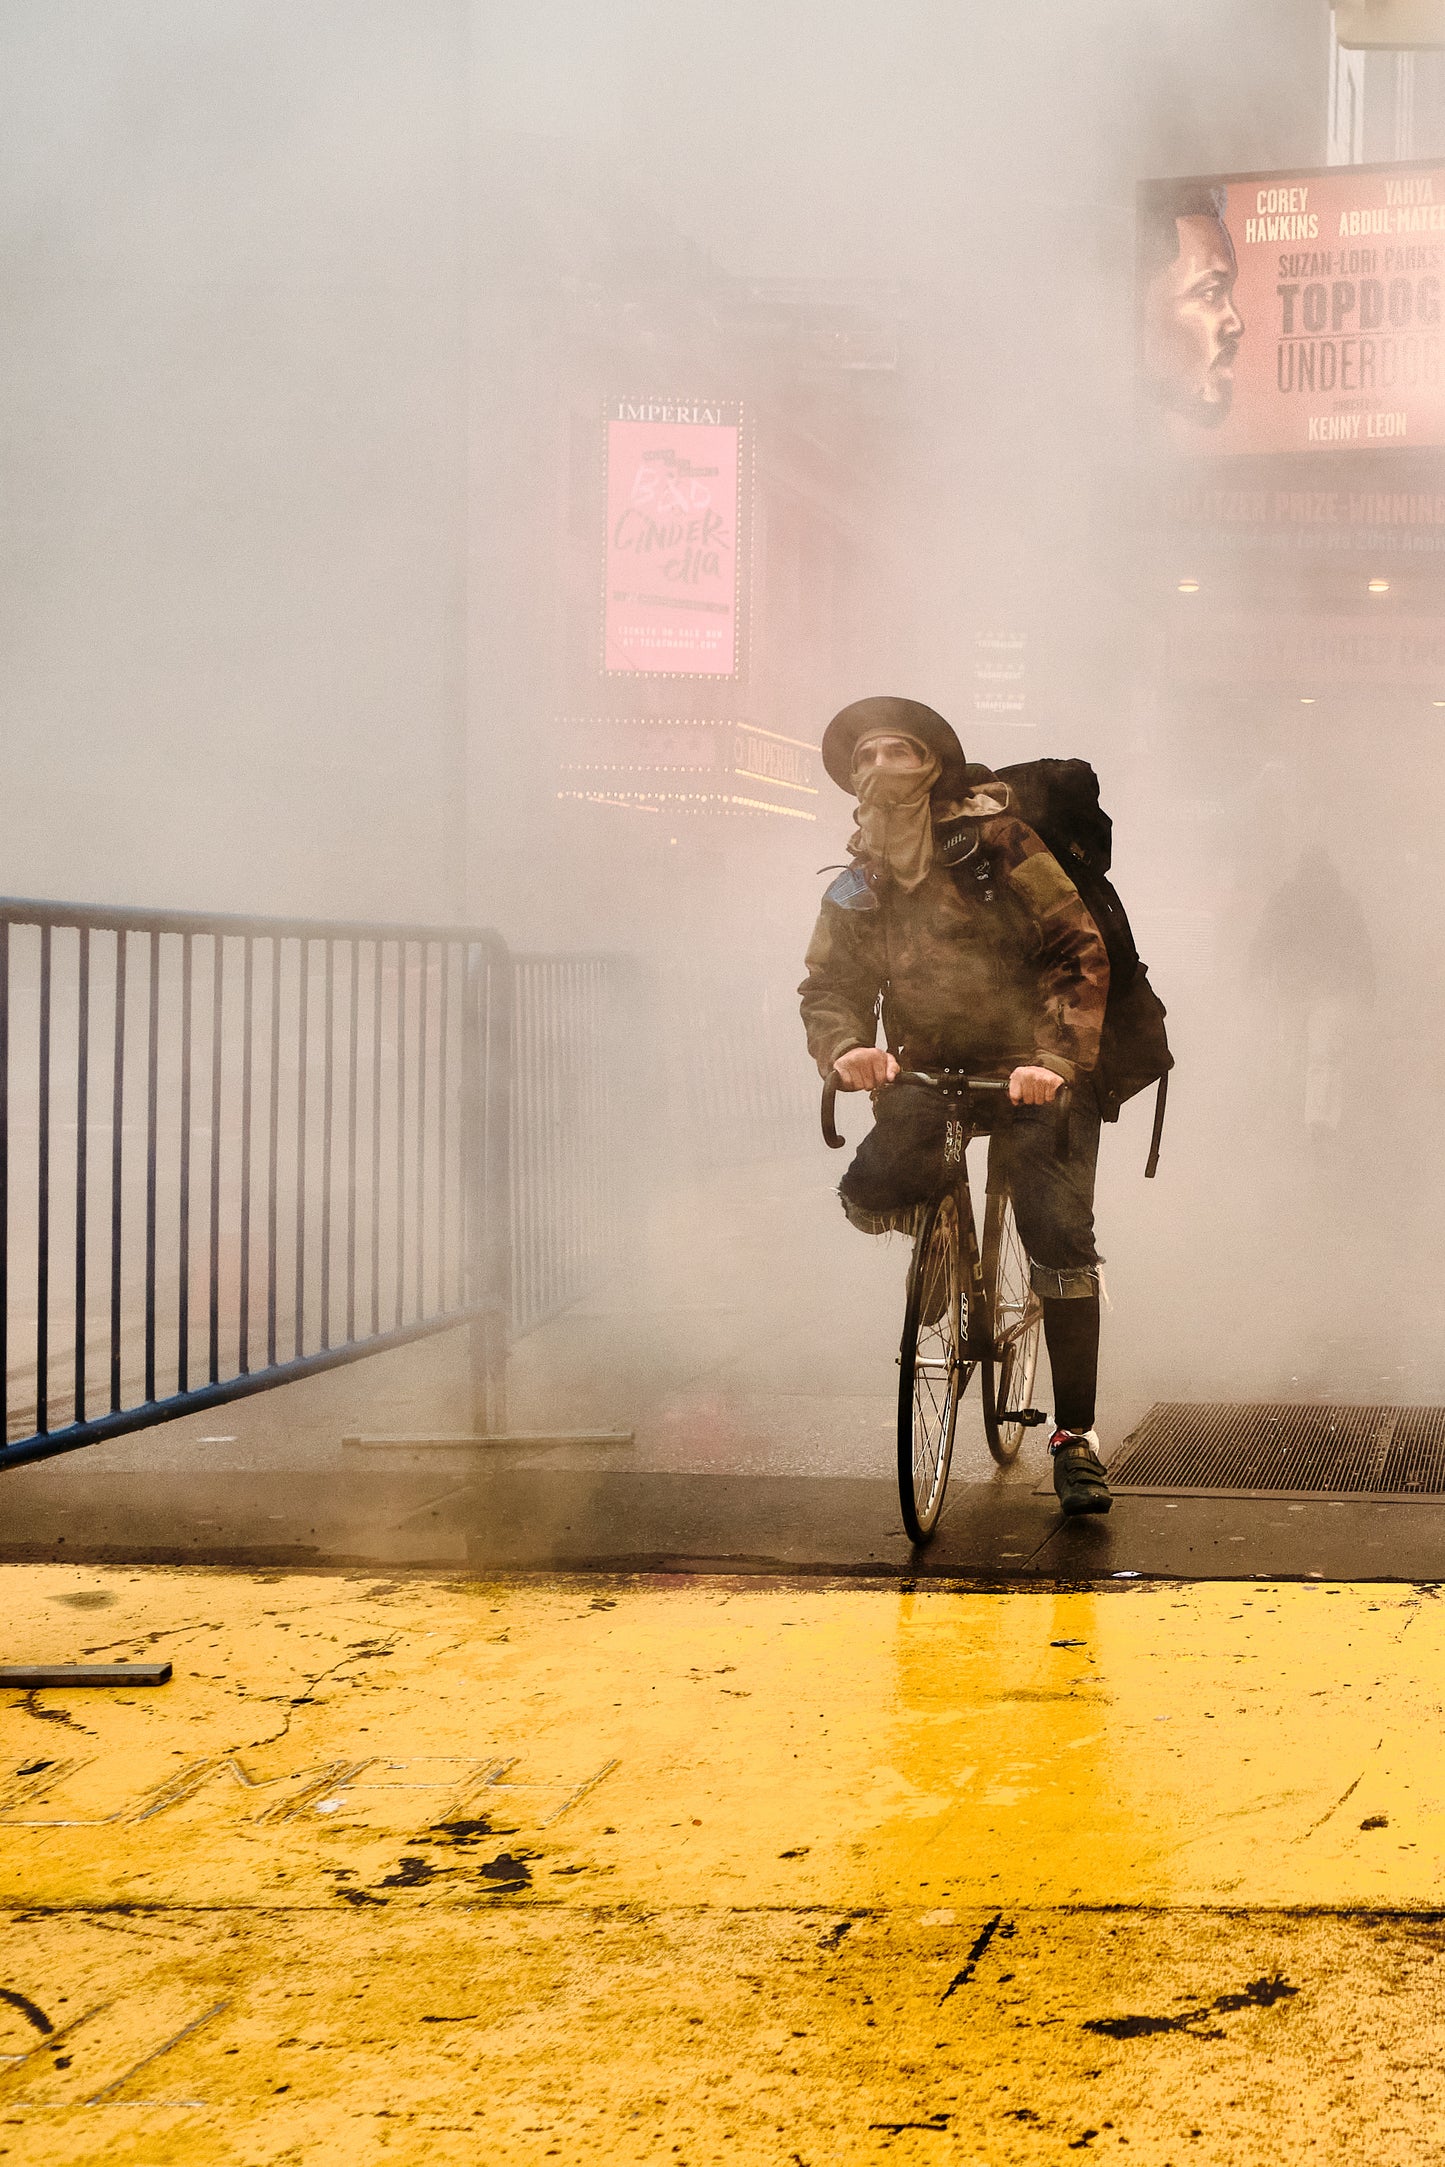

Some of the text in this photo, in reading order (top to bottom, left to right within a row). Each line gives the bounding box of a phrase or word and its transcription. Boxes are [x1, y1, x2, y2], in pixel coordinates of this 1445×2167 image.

[1256, 186, 1309, 215] COREY
[1385, 179, 1433, 206] YAHYA
[1245, 213, 1319, 243] HAWKINS
[1278, 248, 1377, 278] SUZAN-LORI
[1276, 275, 1441, 334] TOPDOG
[1308, 412, 1407, 440] KENNY LEON
